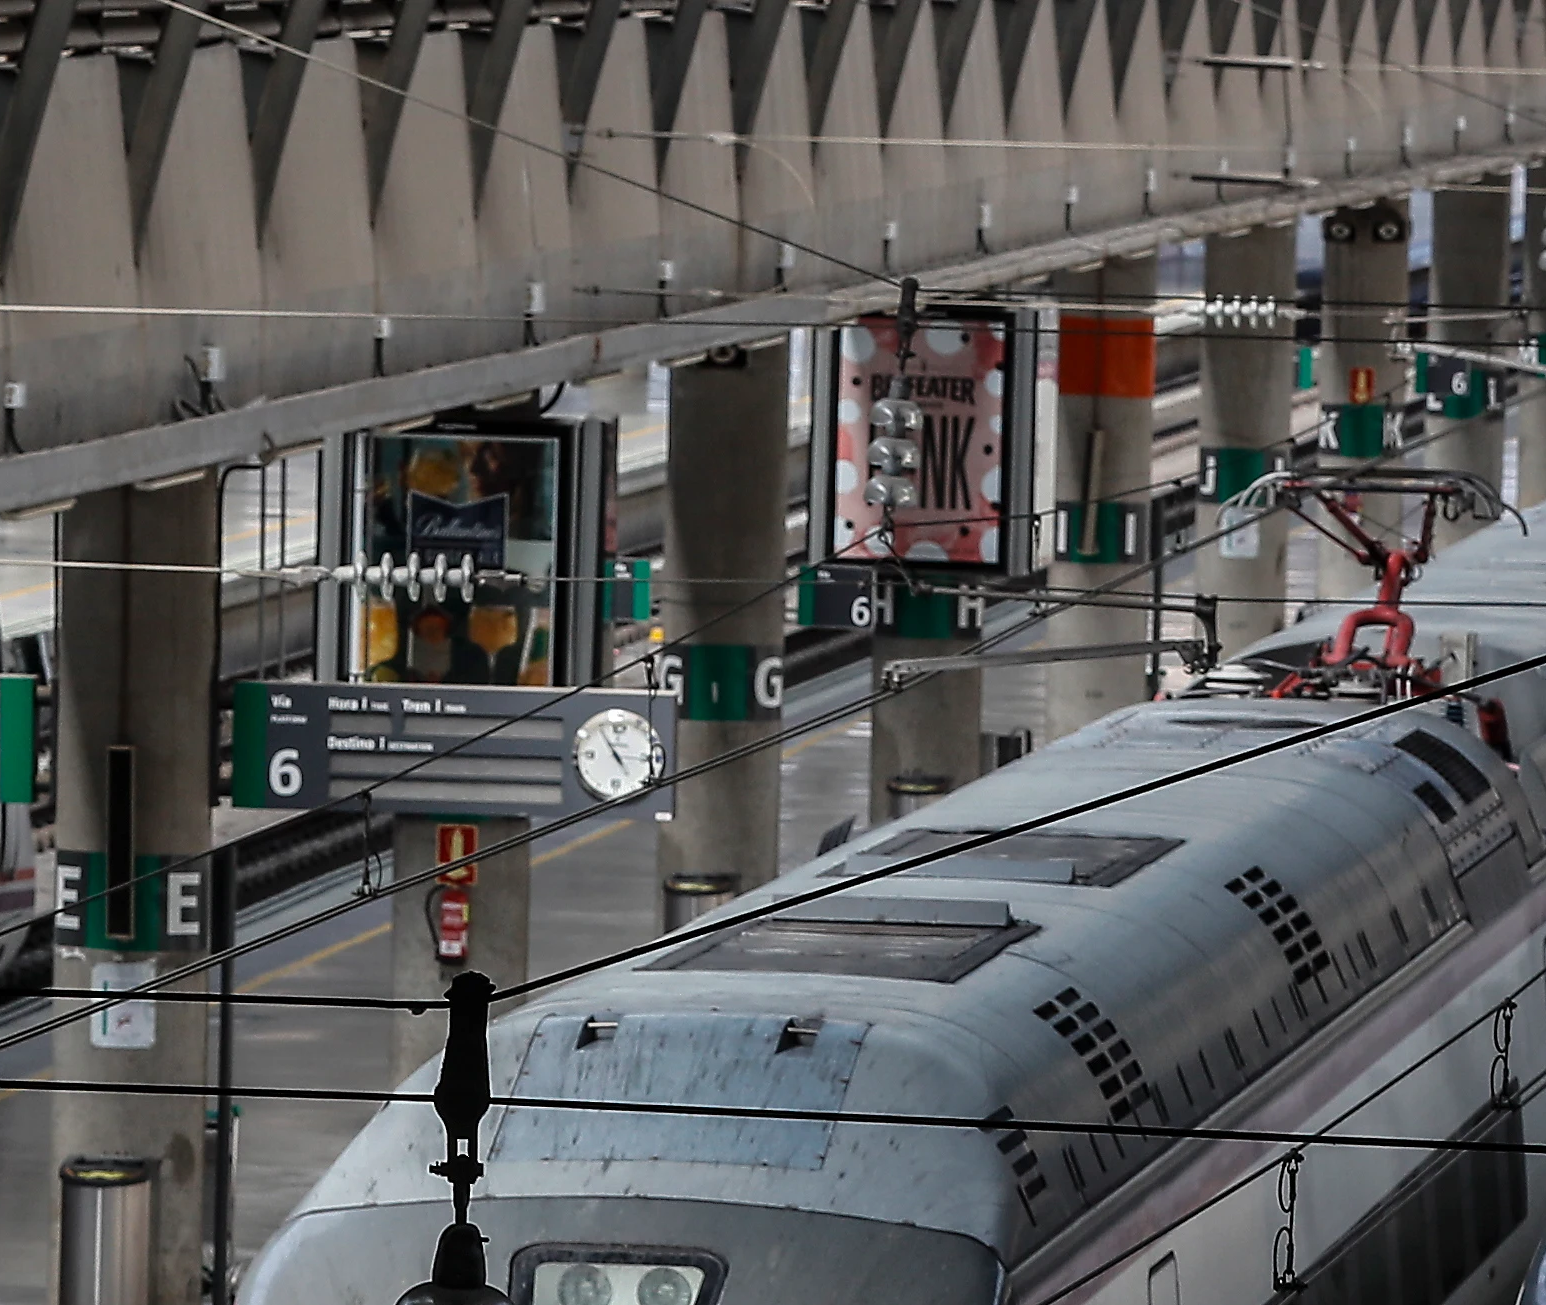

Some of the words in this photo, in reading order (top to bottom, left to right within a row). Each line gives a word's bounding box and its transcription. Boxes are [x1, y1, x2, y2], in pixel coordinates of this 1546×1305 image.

[1451, 371, 1469, 396] 6
[1319, 410, 1340, 449] K
[1383, 411, 1403, 449] K
[851, 595, 871, 627] 6
[754, 655, 784, 709] G
[268, 748, 303, 797] 6
[54, 864, 83, 931] E
[166, 871, 202, 936] E
